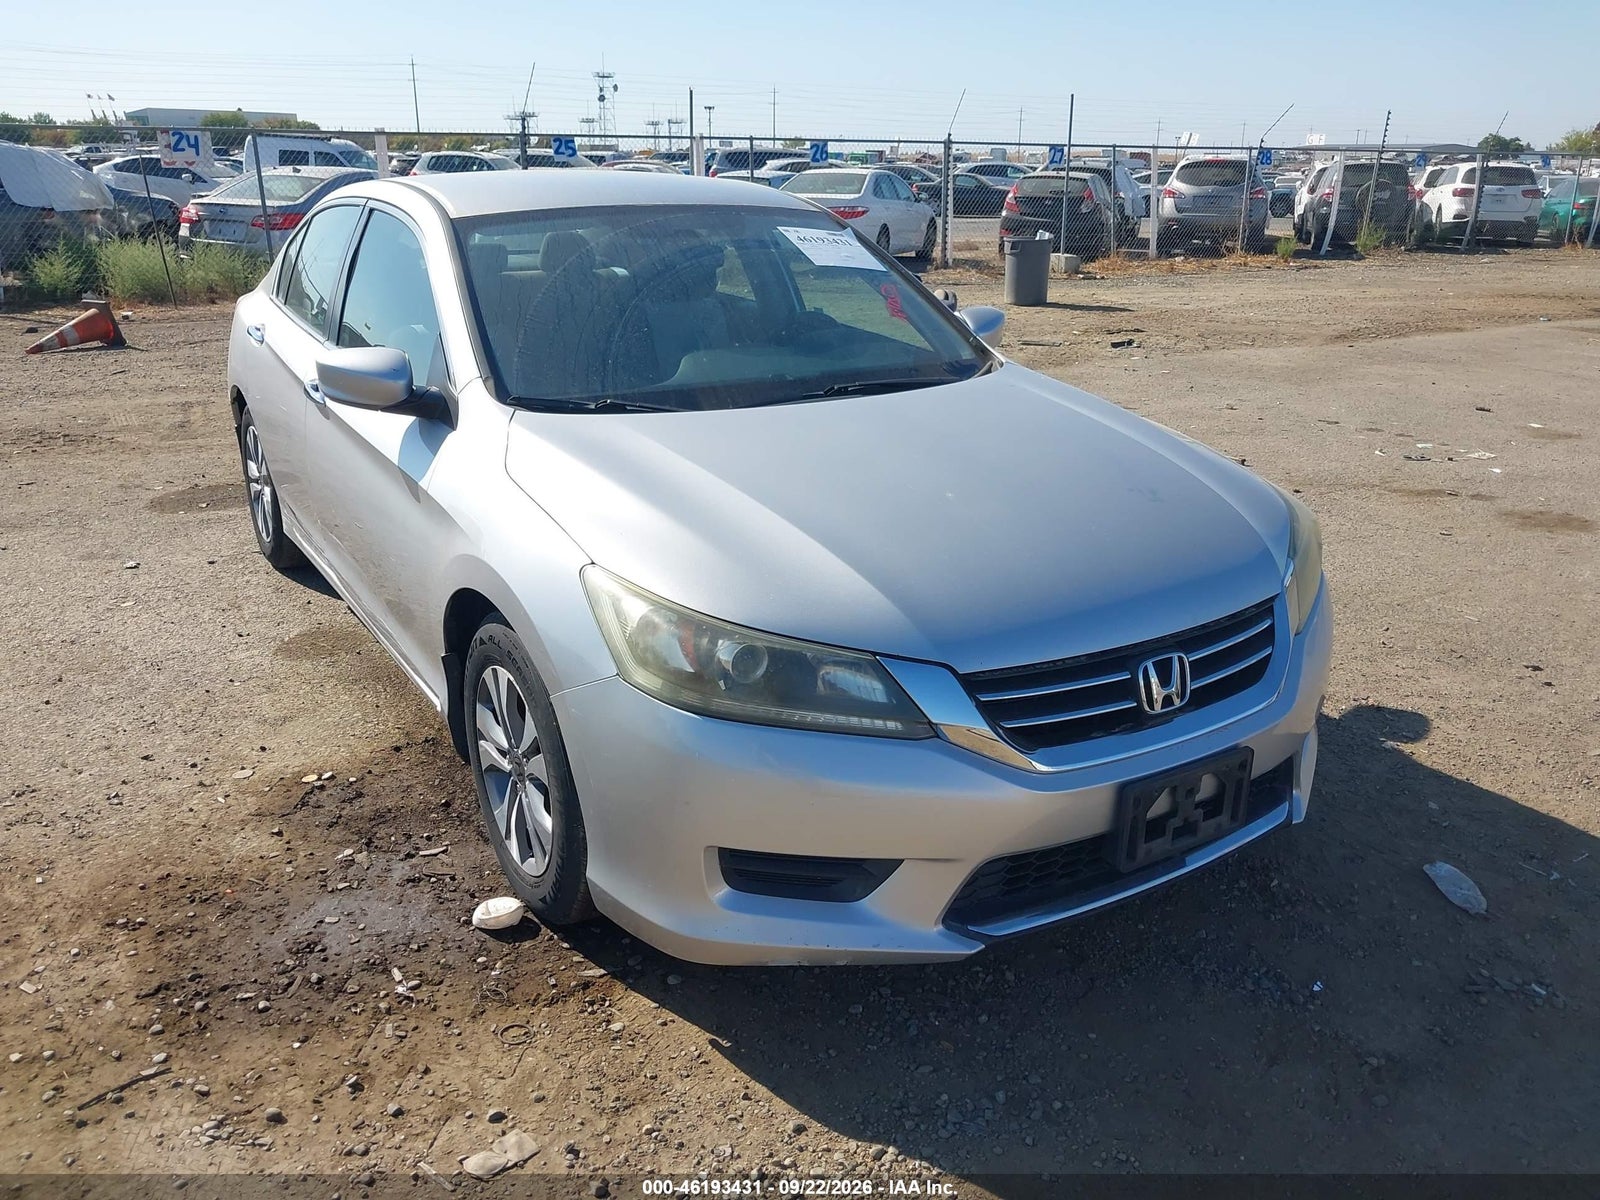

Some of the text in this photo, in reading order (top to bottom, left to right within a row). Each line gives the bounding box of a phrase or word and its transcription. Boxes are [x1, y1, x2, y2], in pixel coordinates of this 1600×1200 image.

[171, 131, 200, 157] 24
[552, 137, 577, 158] 25
[810, 143, 829, 163] 26
[1048, 147, 1064, 165] 27
[1259, 150, 1273, 166] 28
[796, 235, 853, 247] 46193431
